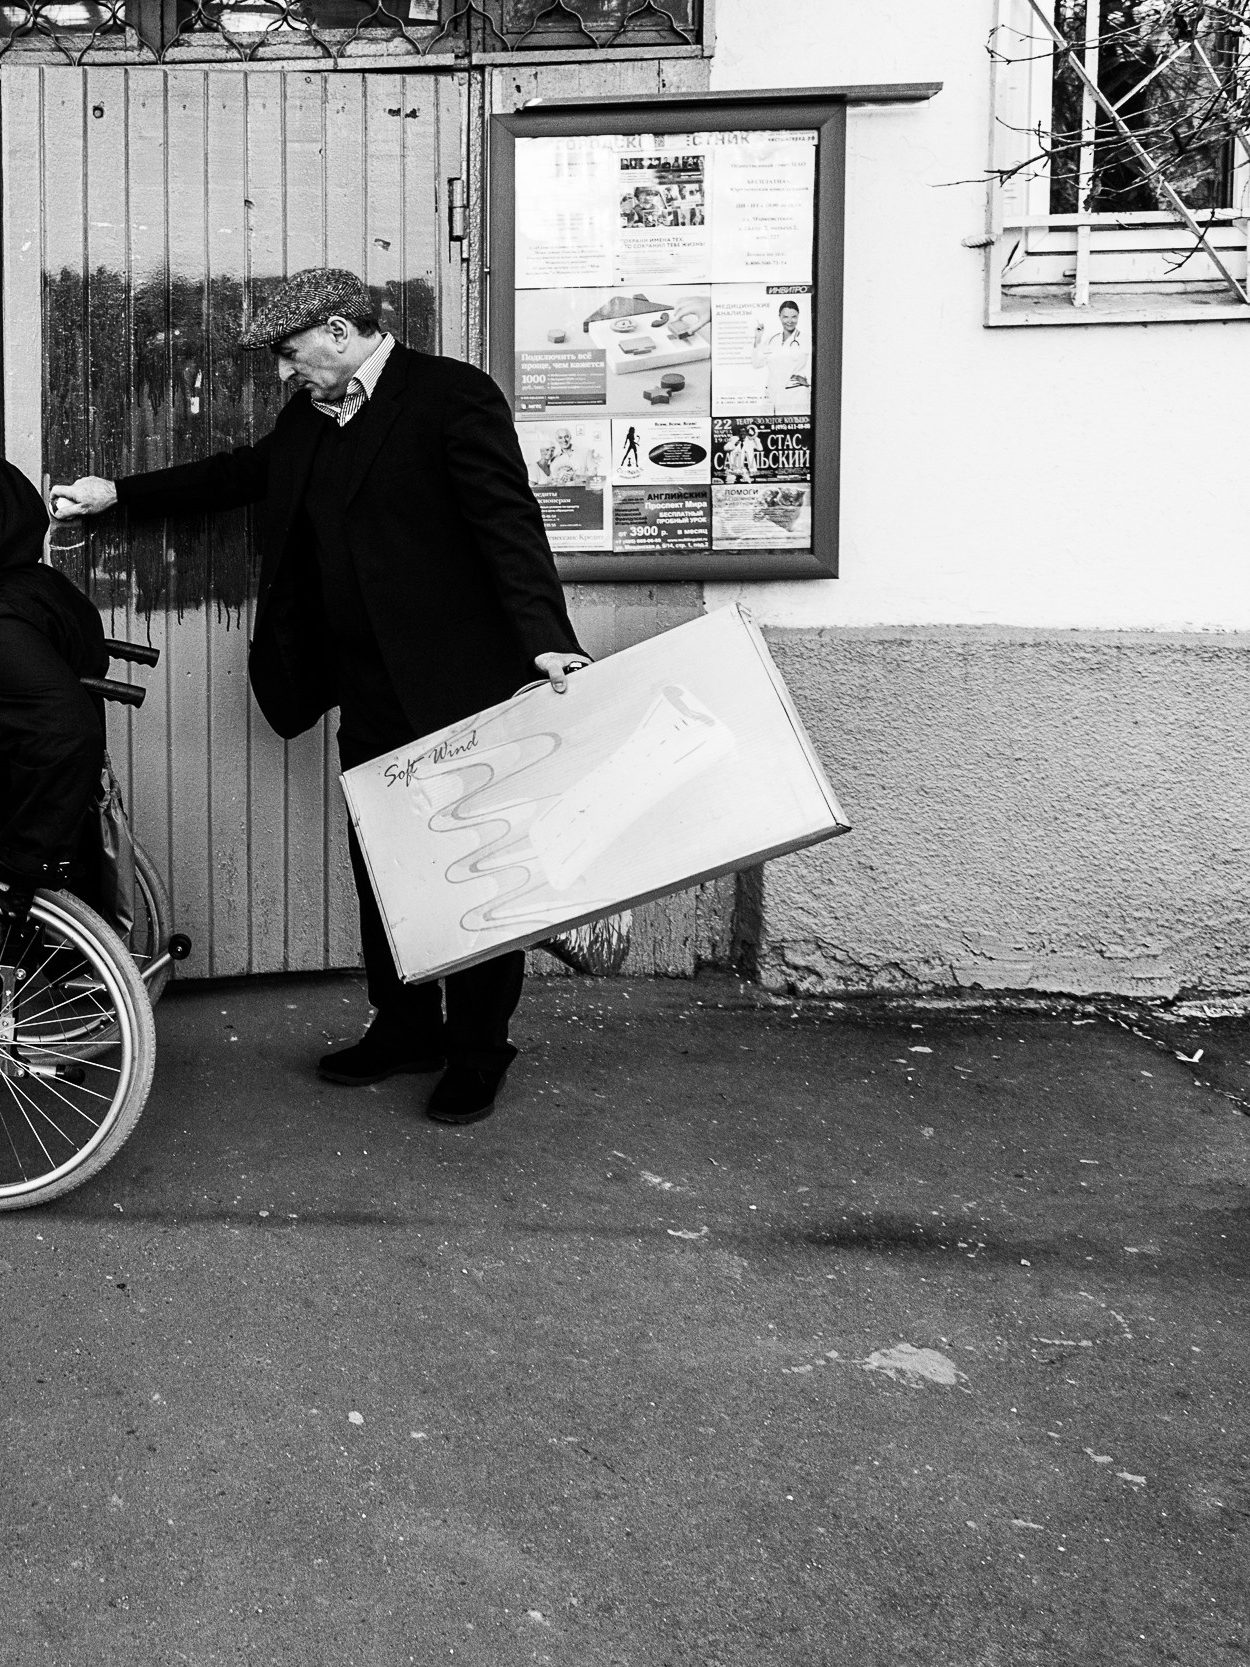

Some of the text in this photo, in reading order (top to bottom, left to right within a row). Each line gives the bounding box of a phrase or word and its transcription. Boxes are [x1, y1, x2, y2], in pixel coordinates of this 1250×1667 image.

[767, 286, 808, 294] ИНВИТРО
[715, 302, 770, 310] МЕДИЦИНСКИЕ
[520, 351, 592, 362] Подключить всё
[520, 363, 551, 371] проще,
[570, 361, 605, 369] кажется
[521, 374, 546, 384] 1000
[713, 418, 732, 430] 22
[767, 433, 802, 450] СТАС
[647, 491, 707, 501] АНГЛИЙСКИЙ
[644, 500, 708, 511] Проспект Мира
[659, 509, 704, 518] БЕСПЛАТНЫЙ
[656, 517, 689, 525] ПРОБНЫЙ
[629, 525, 659, 537] 3900
[683, 528, 709, 536] месяц
[384, 729, 479, 788] Soft Wind
